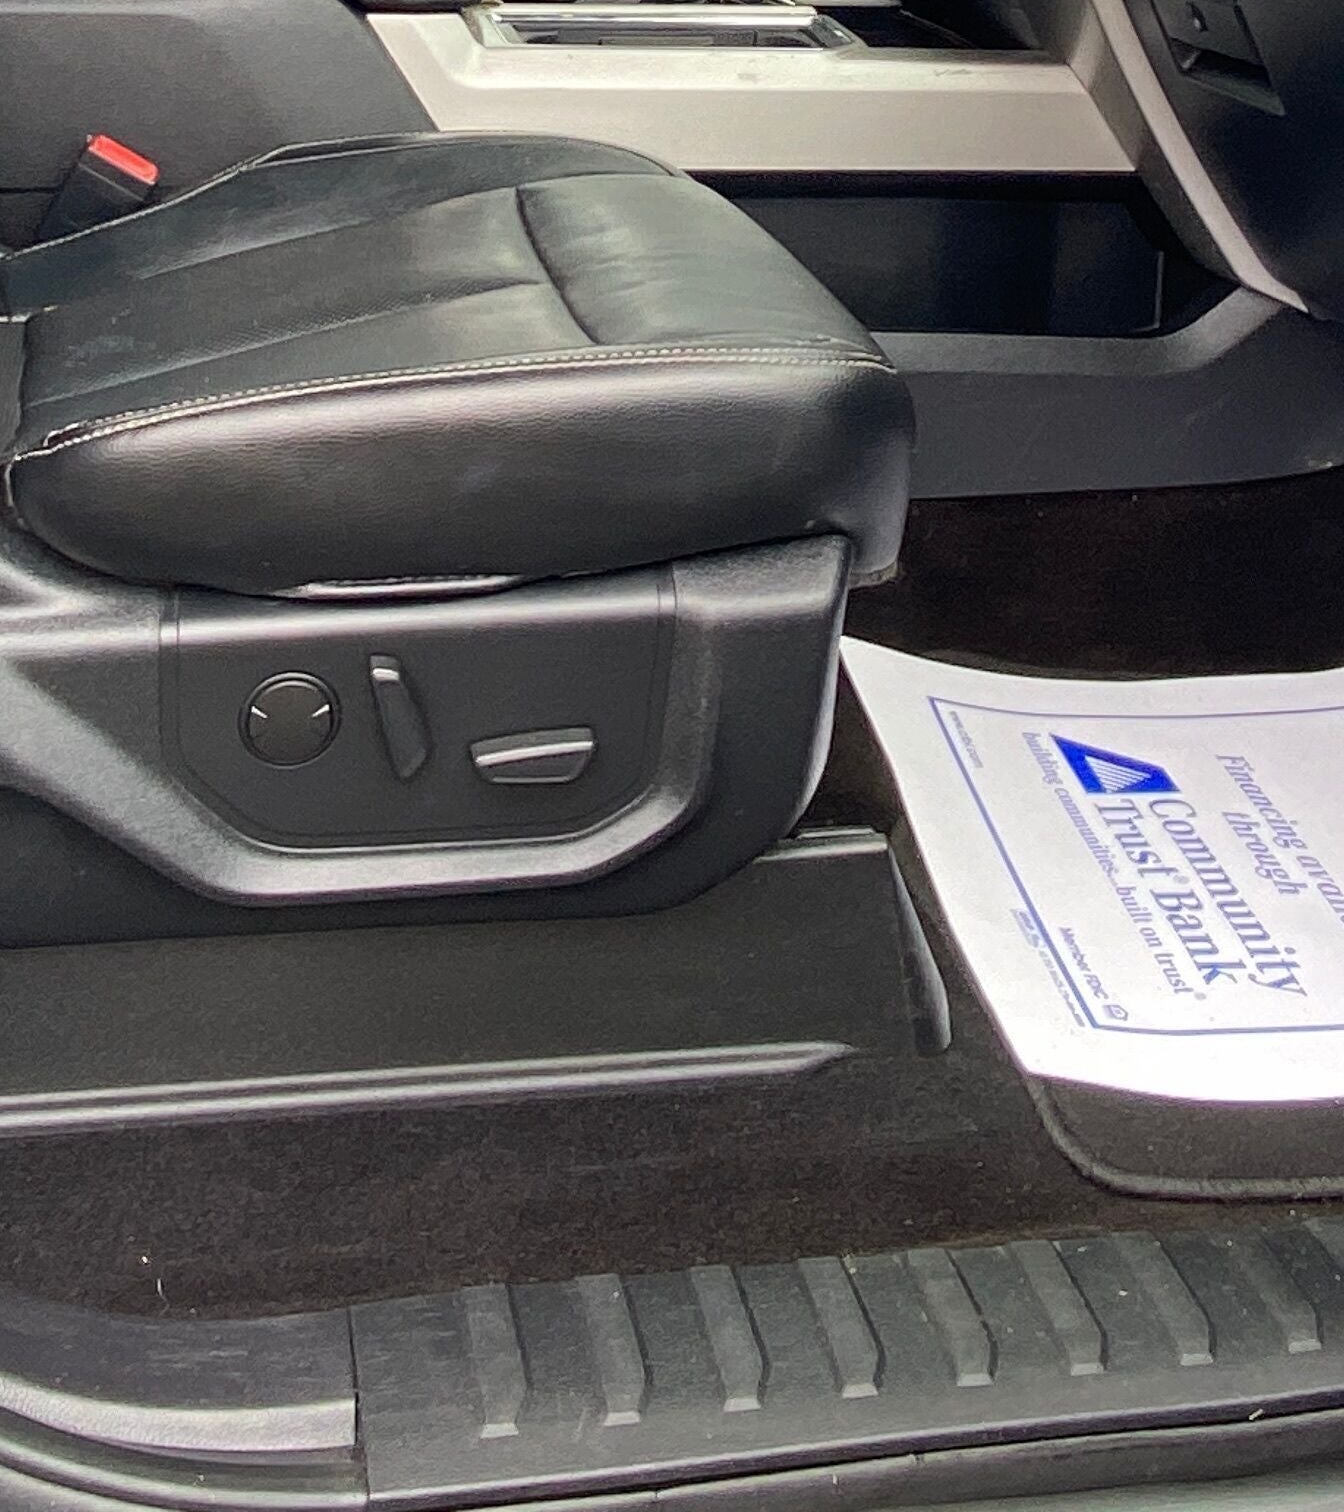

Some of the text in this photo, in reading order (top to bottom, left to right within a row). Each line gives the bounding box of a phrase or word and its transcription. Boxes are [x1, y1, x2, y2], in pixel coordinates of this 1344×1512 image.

[1022, 731, 1063, 786] building
[1140, 926, 1163, 948] on
[1215, 754, 1309, 850] Financing
[1148, 797, 1308, 997] Community
[1222, 811, 1308, 895] through
[1150, 886, 1247, 985] Bank
